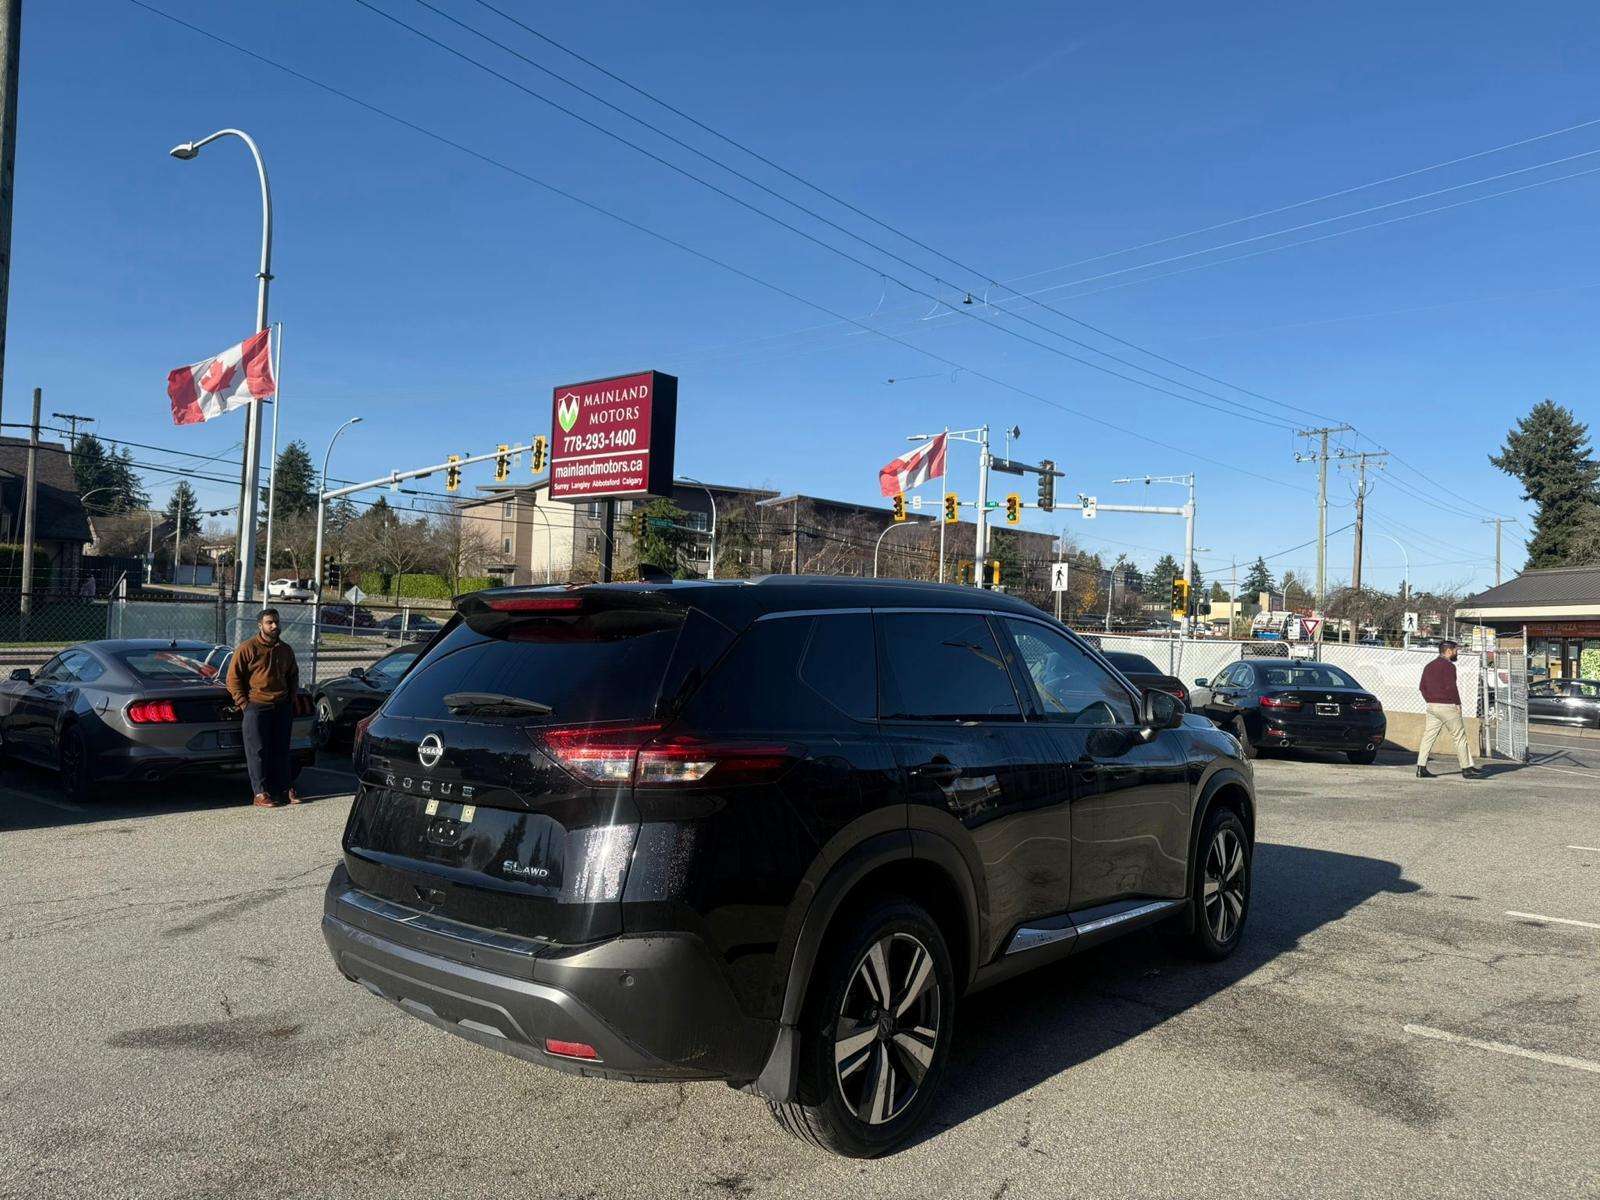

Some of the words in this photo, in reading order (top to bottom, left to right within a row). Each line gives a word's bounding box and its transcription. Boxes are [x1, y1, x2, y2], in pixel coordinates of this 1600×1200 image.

[584, 385, 648, 407] MAINLAND
[589, 406, 640, 425] MOTORS
[564, 428, 637, 453] 778-293-1400
[555, 459, 643, 478] mainlandmotors.ca
[571, 480, 591, 490] Langley
[592, 478, 620, 488] Abbotsford
[622, 476, 643, 486] Calgary
[386, 775, 474, 797] ROGUE
